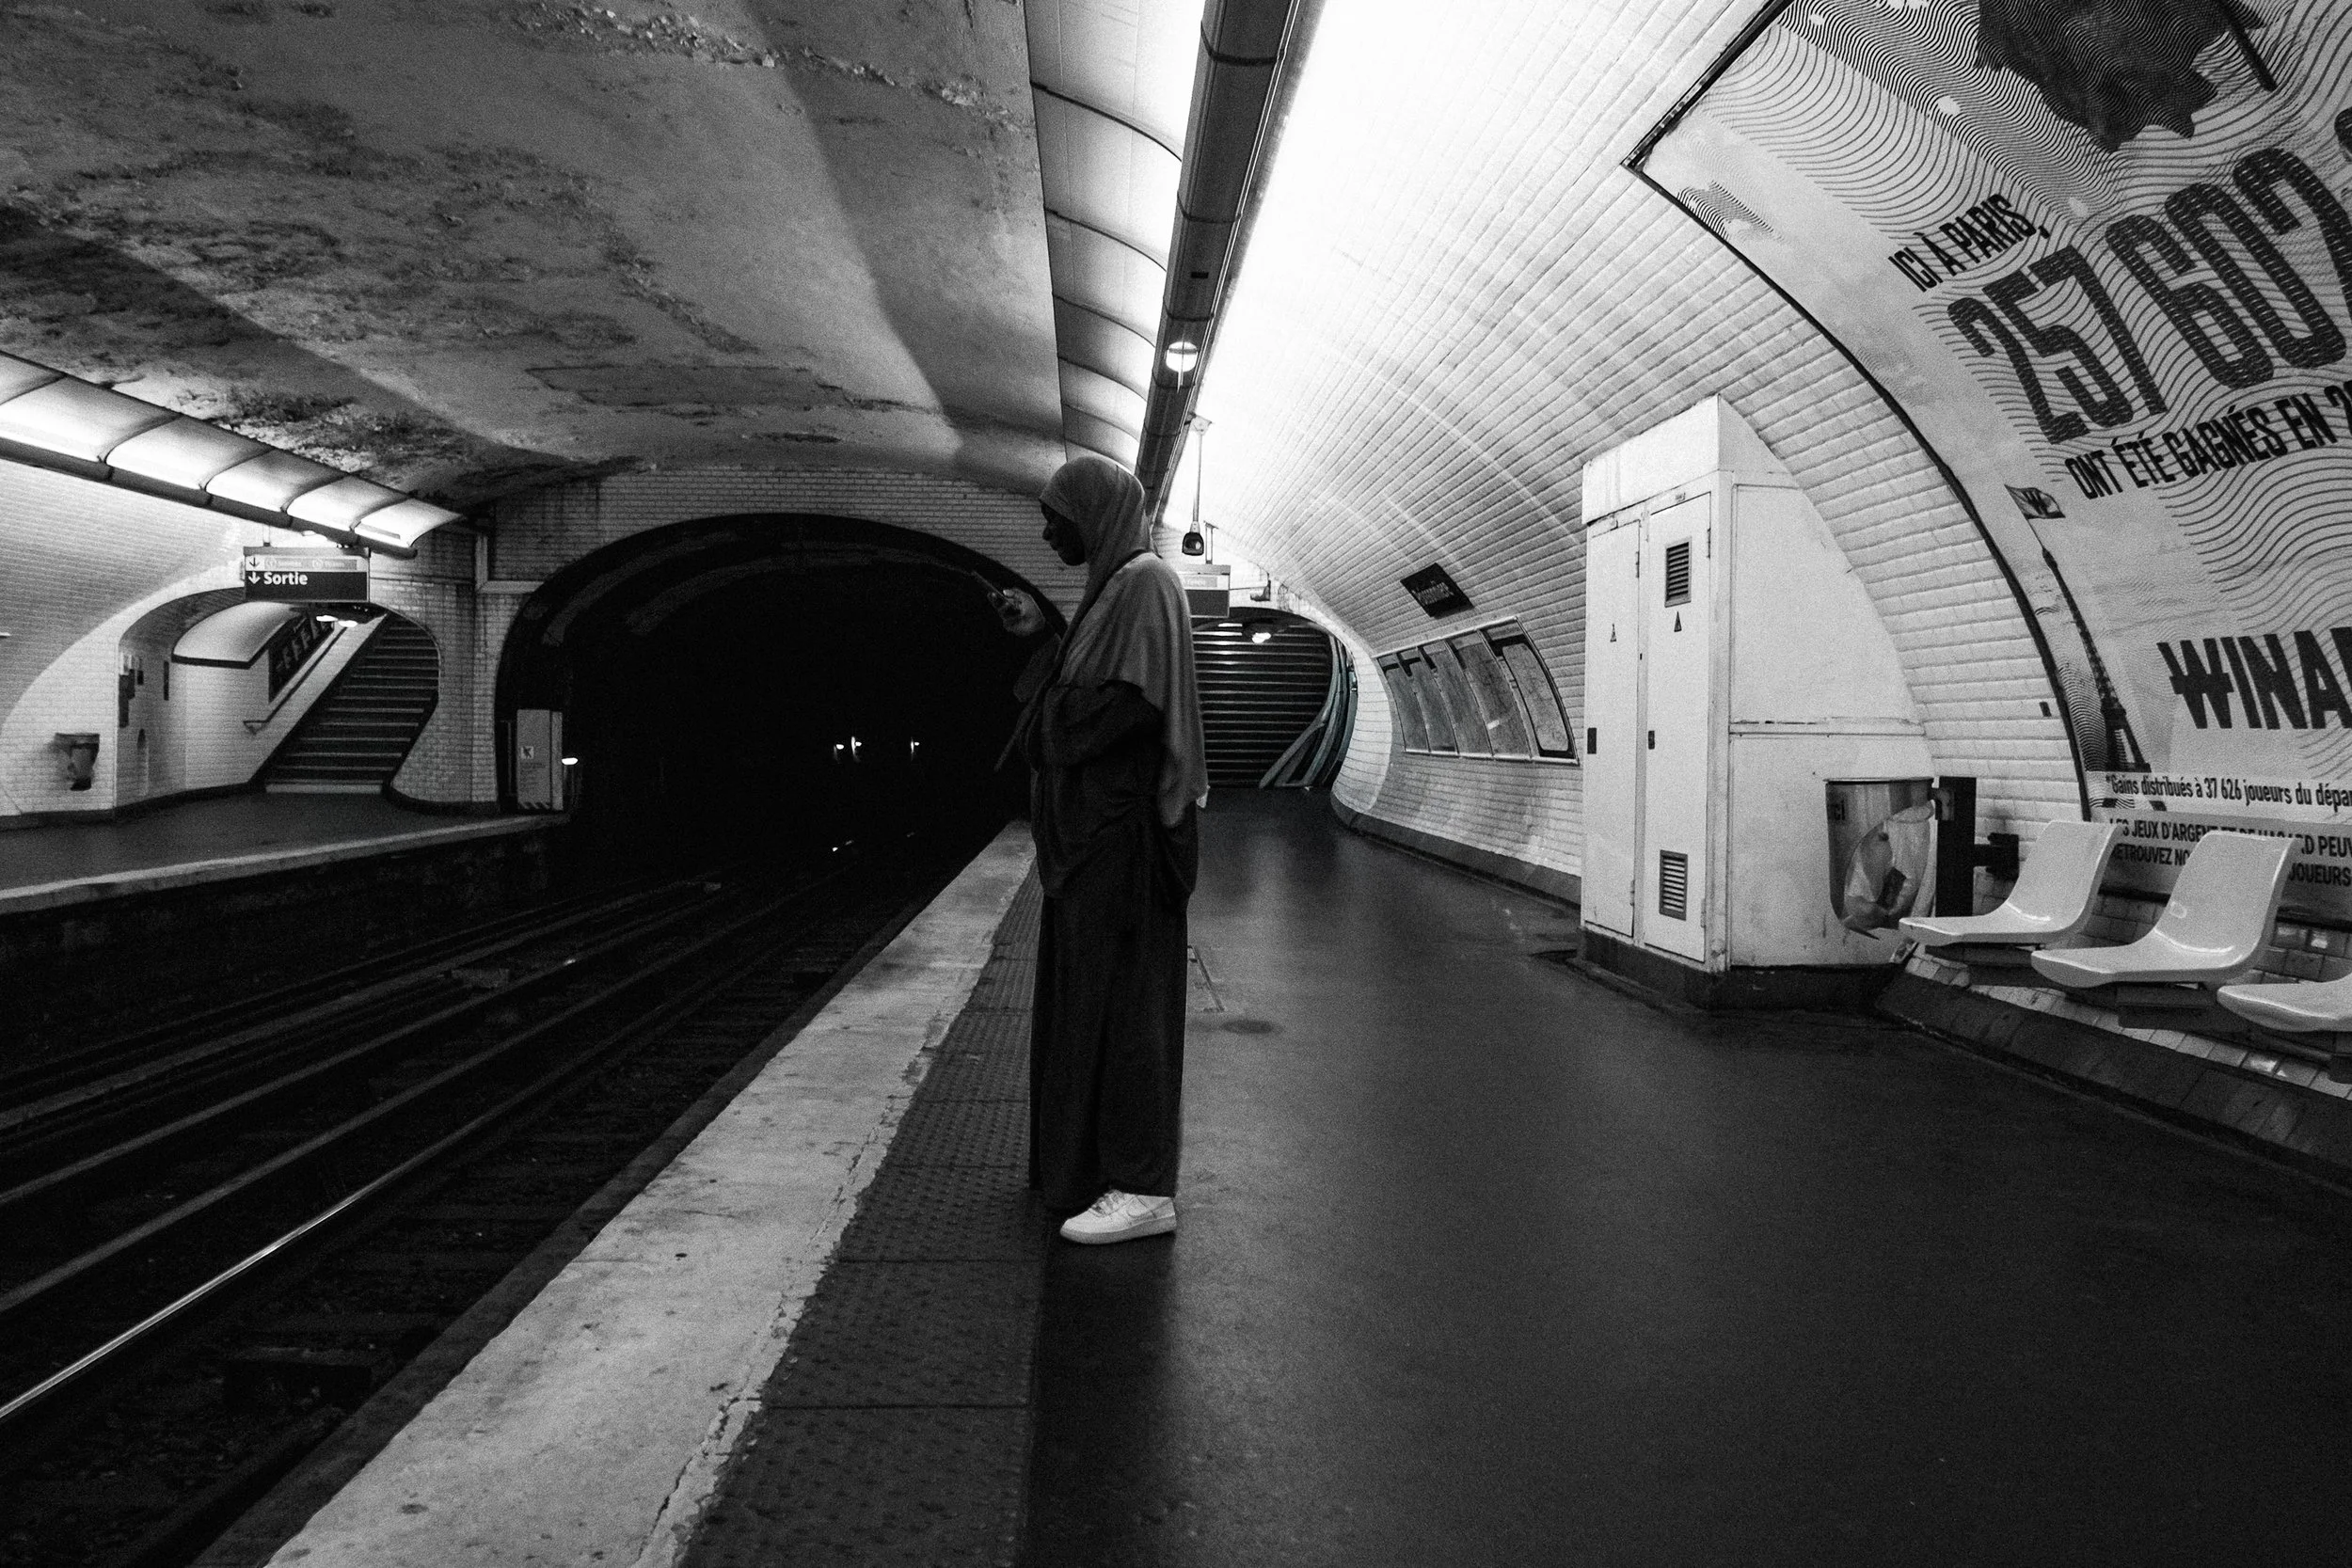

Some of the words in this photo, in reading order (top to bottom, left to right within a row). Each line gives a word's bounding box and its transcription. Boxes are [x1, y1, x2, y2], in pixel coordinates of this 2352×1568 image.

[1939, 194, 2049, 263] PARIS,
[1887, 246, 1944, 293] ICI
[1913, 231, 1967, 277] À
[1947, 245, 2168, 445] 257
[2064, 449, 2123, 499] ONT
[2110, 430, 2177, 488] ÉTÉ
[2162, 404, 2289, 478] GAGNÉS
[2273, 392, 2338, 451] EN
[263, 571, 309, 585] Sortie
[2140, 775, 2194, 799] distribués
[2195, 777, 2203, 799] à
[2204, 777, 2218, 800] 37
[2220, 778, 2242, 800] 626
[2243, 779, 2293, 806] joueurs
[2296, 782, 2312, 805] du
[2131, 819, 2159, 840] JEUX
[2161, 821, 2218, 843] D'ARGE
